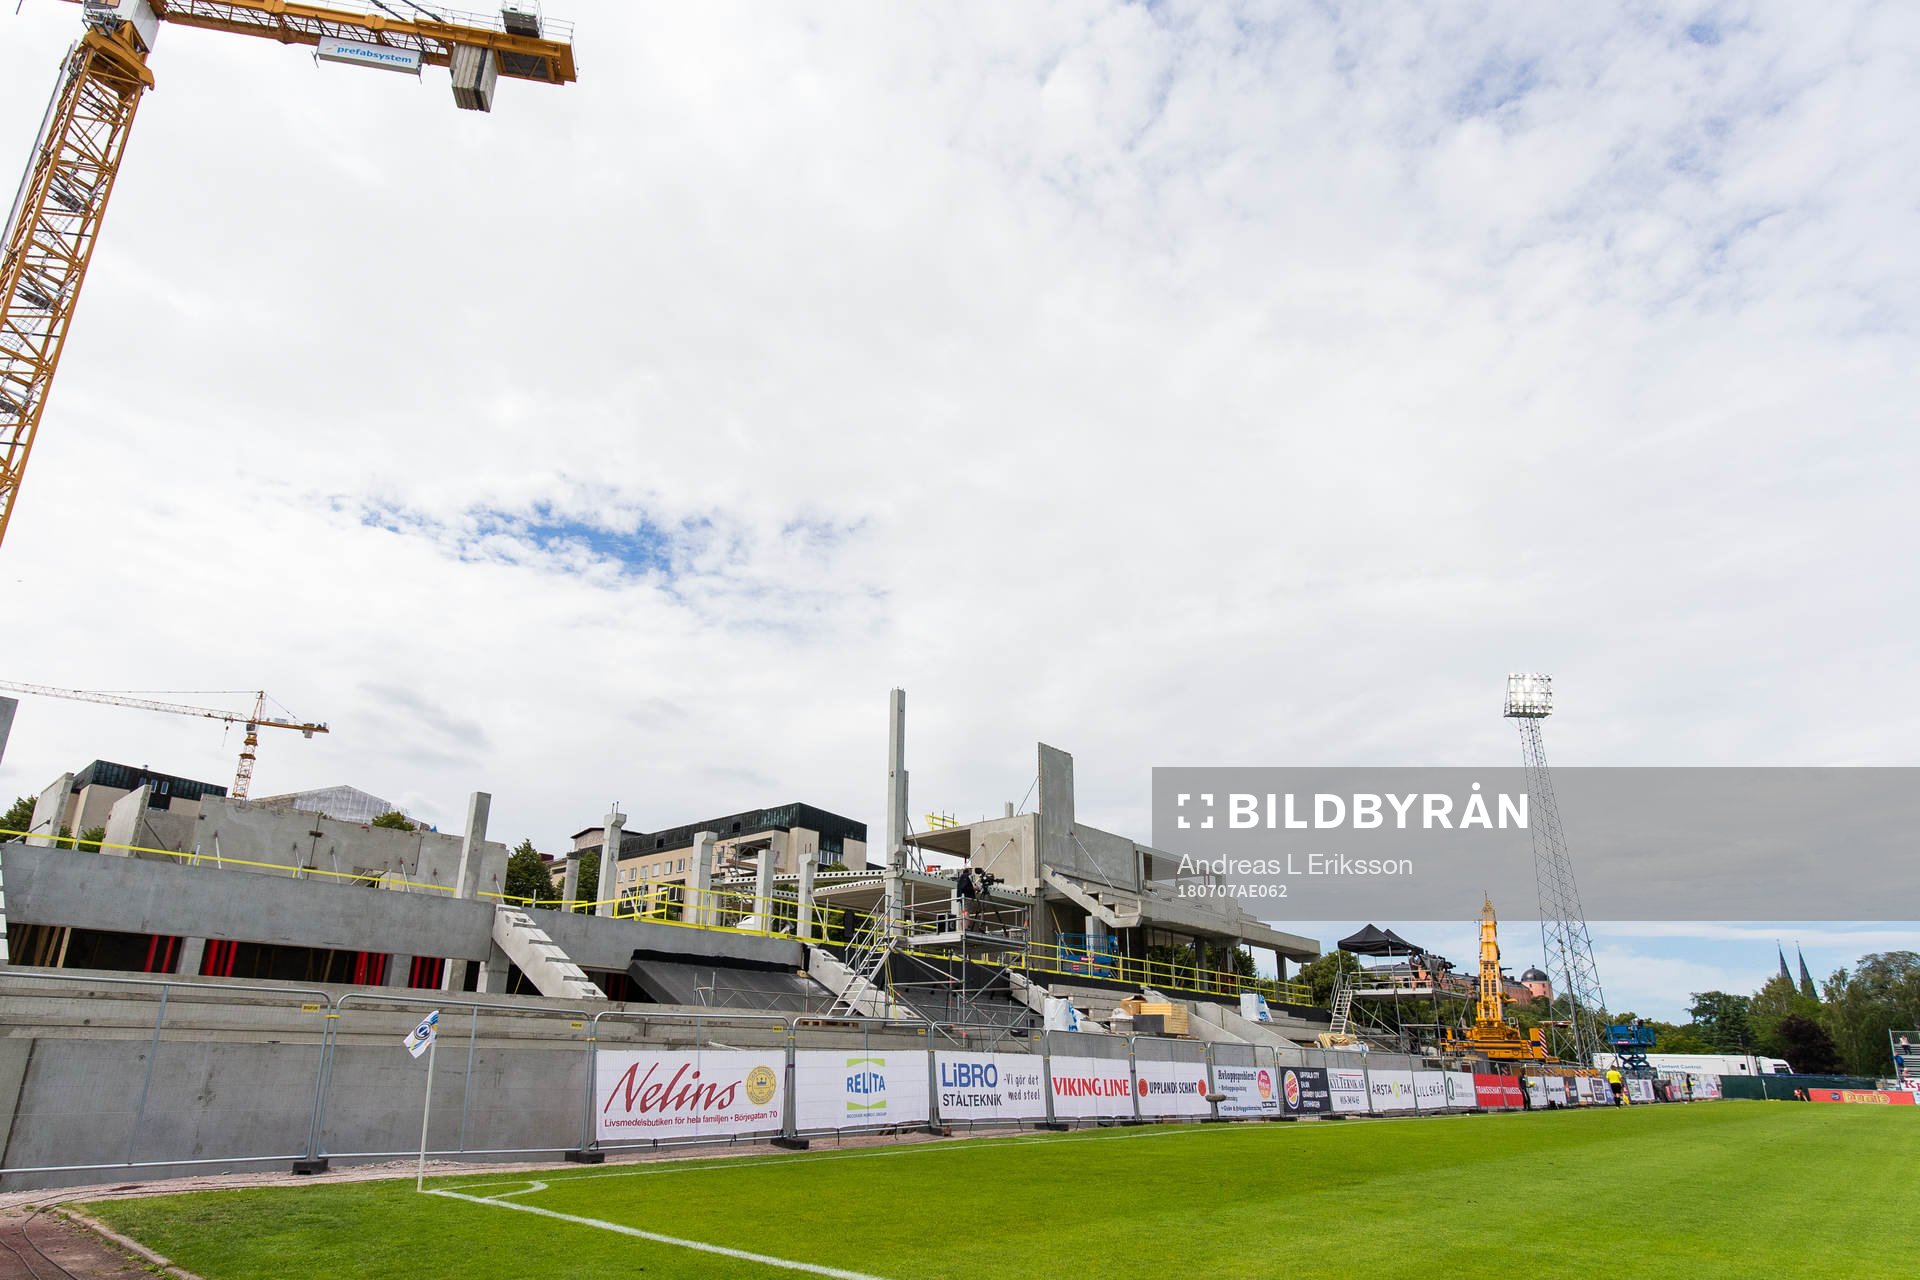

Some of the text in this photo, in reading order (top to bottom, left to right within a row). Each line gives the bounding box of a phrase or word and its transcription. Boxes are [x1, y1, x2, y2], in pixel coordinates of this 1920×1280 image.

[336, 46, 412, 63] prefabsystem
[846, 1071, 886, 1094] RELITA
[942, 1062, 998, 1088] LiBRO
[1015, 1074, 1026, 1087] gör
[1028, 1074, 1039, 1086] det
[604, 1062, 742, 1114] Nelins
[1008, 1088, 1040, 1101] med steel
[1052, 1077, 1130, 1096] VIKING LINE
[1149, 1081, 1197, 1094] UPPLANDS SCHAKT
[1372, 1080, 1412, 1094] ÅRSTA TAK
[604, 1117, 672, 1128] Livsmedelsbutiken
[674, 1116, 685, 1125] för
[686, 1116, 702, 1124] hela
[702, 1114, 728, 1124] familjen
[769, 1110, 778, 1119] 70
